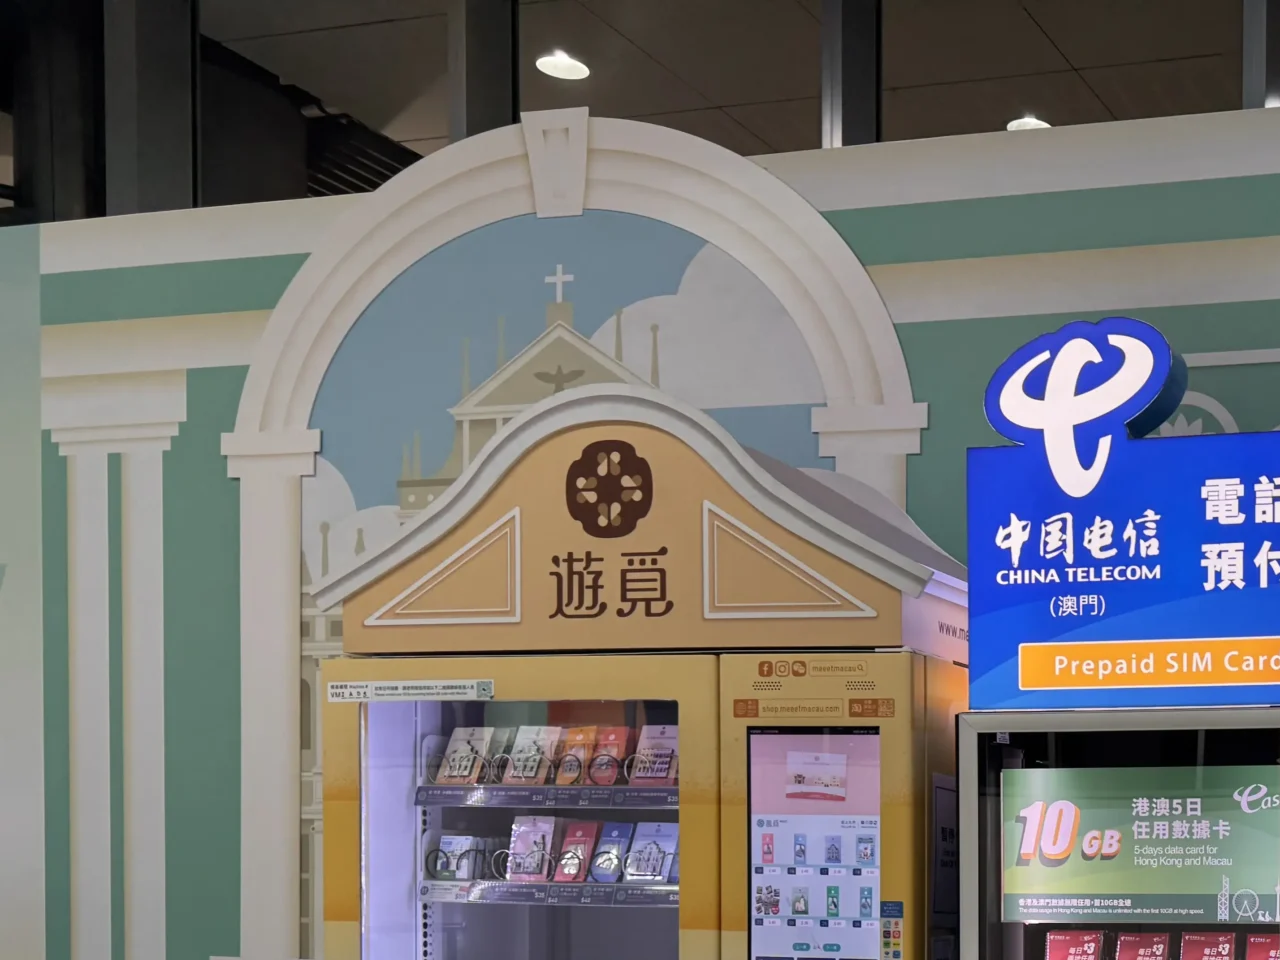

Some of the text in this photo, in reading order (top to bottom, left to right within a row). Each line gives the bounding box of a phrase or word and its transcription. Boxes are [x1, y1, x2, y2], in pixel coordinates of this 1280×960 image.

[995, 508, 1161, 568] 中国电信
[548, 545, 675, 620] 遊覓
[996, 564, 1161, 585] CHINA TELECOM
[1049, 594, 1106, 618] (澳門)
[1053, 652, 1155, 680] Prepaid
[1166, 650, 1213, 672] SIM
[1131, 797, 1203, 817] 港澳5日
[1016, 799, 1122, 862] 10 GB
[1131, 820, 1232, 840] 任用數據卡
[1134, 845, 1219, 856] 5-days data card for
[1134, 856, 1233, 869] Hong Kong and Macau
